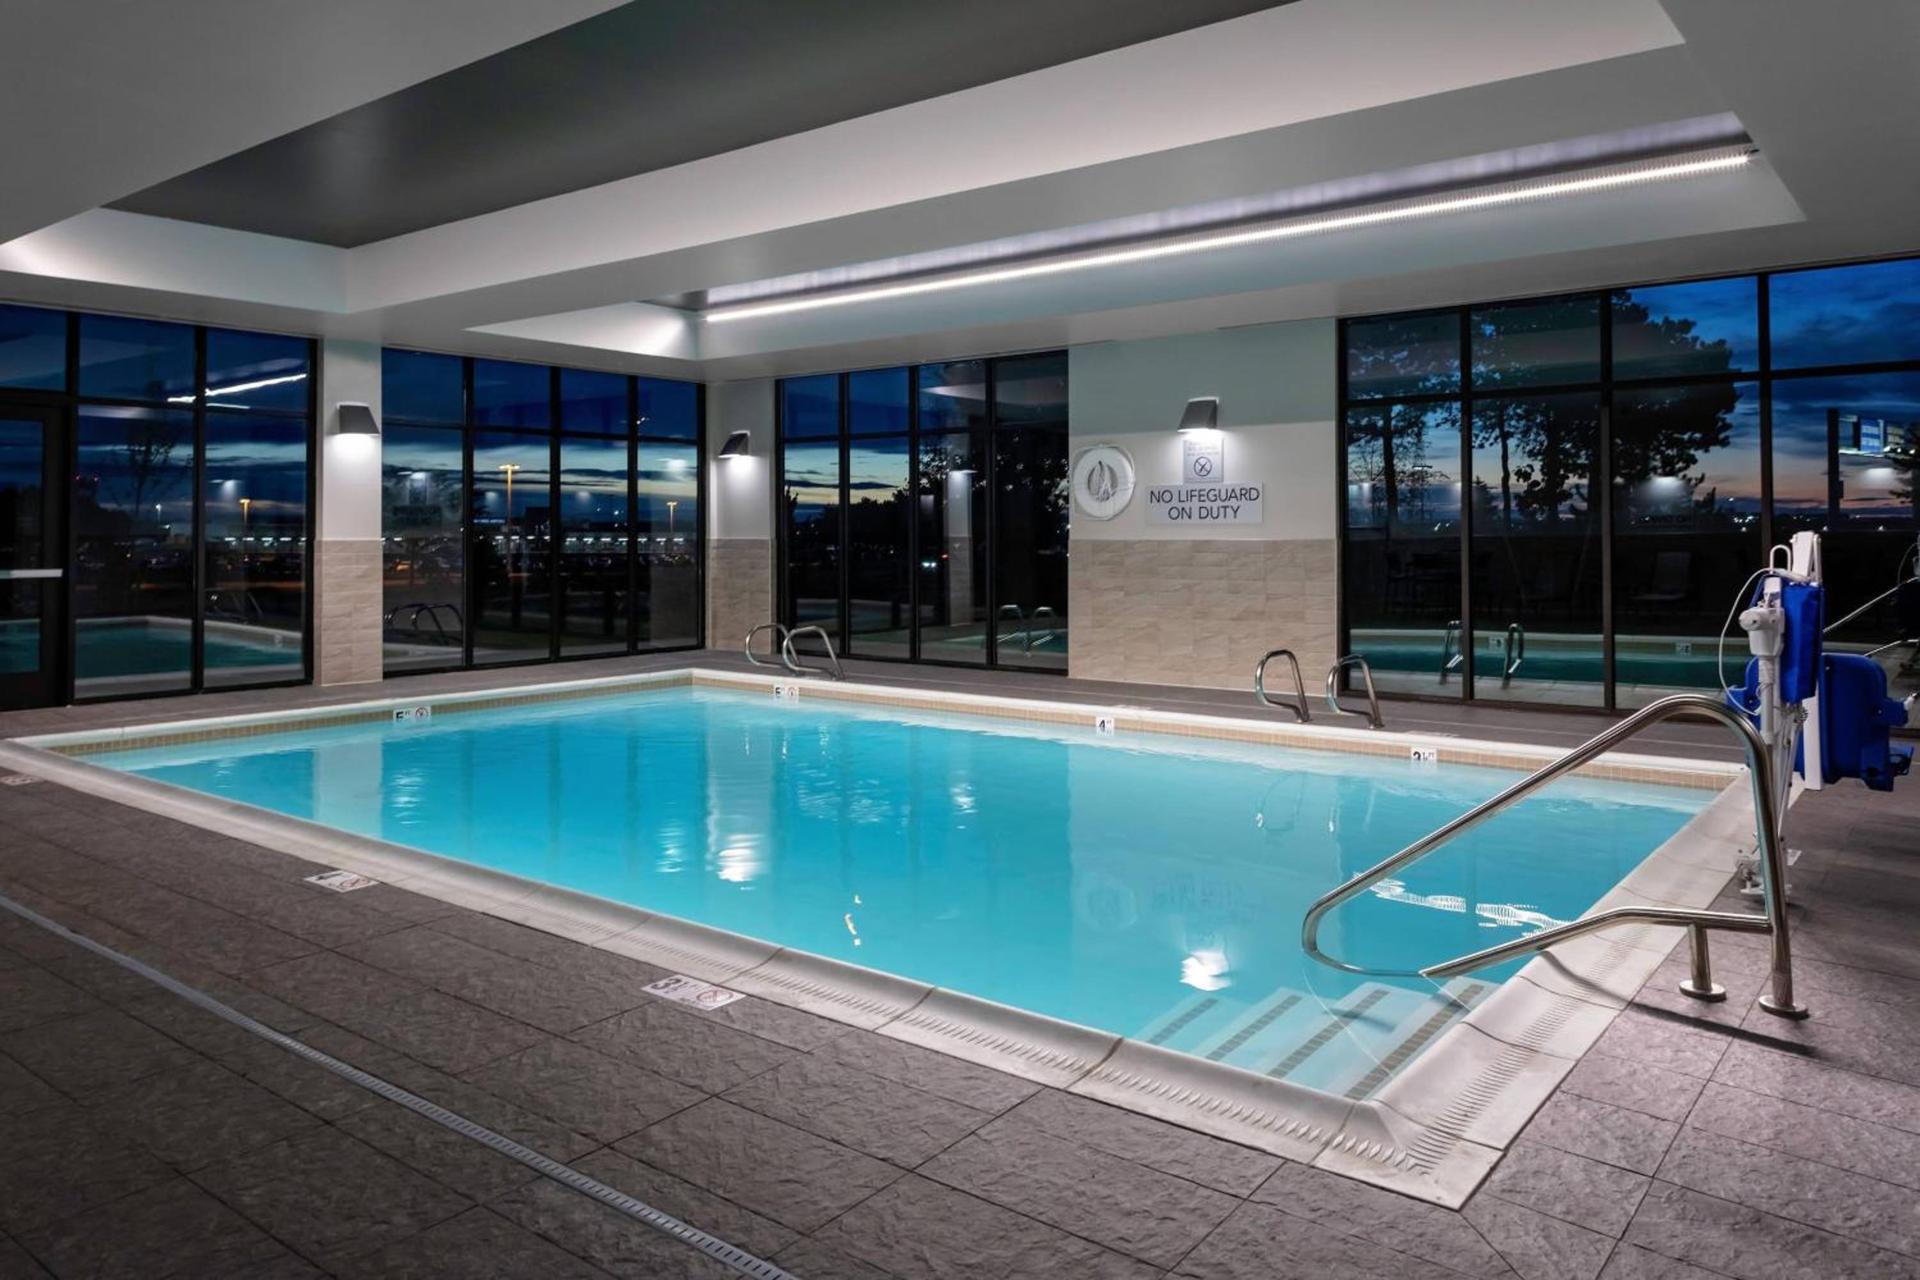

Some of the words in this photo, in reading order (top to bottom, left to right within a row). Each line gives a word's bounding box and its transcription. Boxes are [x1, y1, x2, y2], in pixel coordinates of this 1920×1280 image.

[1150, 489, 1173, 504] NO
[1178, 487, 1260, 503] LIFEGUARD
[1168, 506, 1192, 520] ON
[1199, 505, 1240, 520] DUTY
